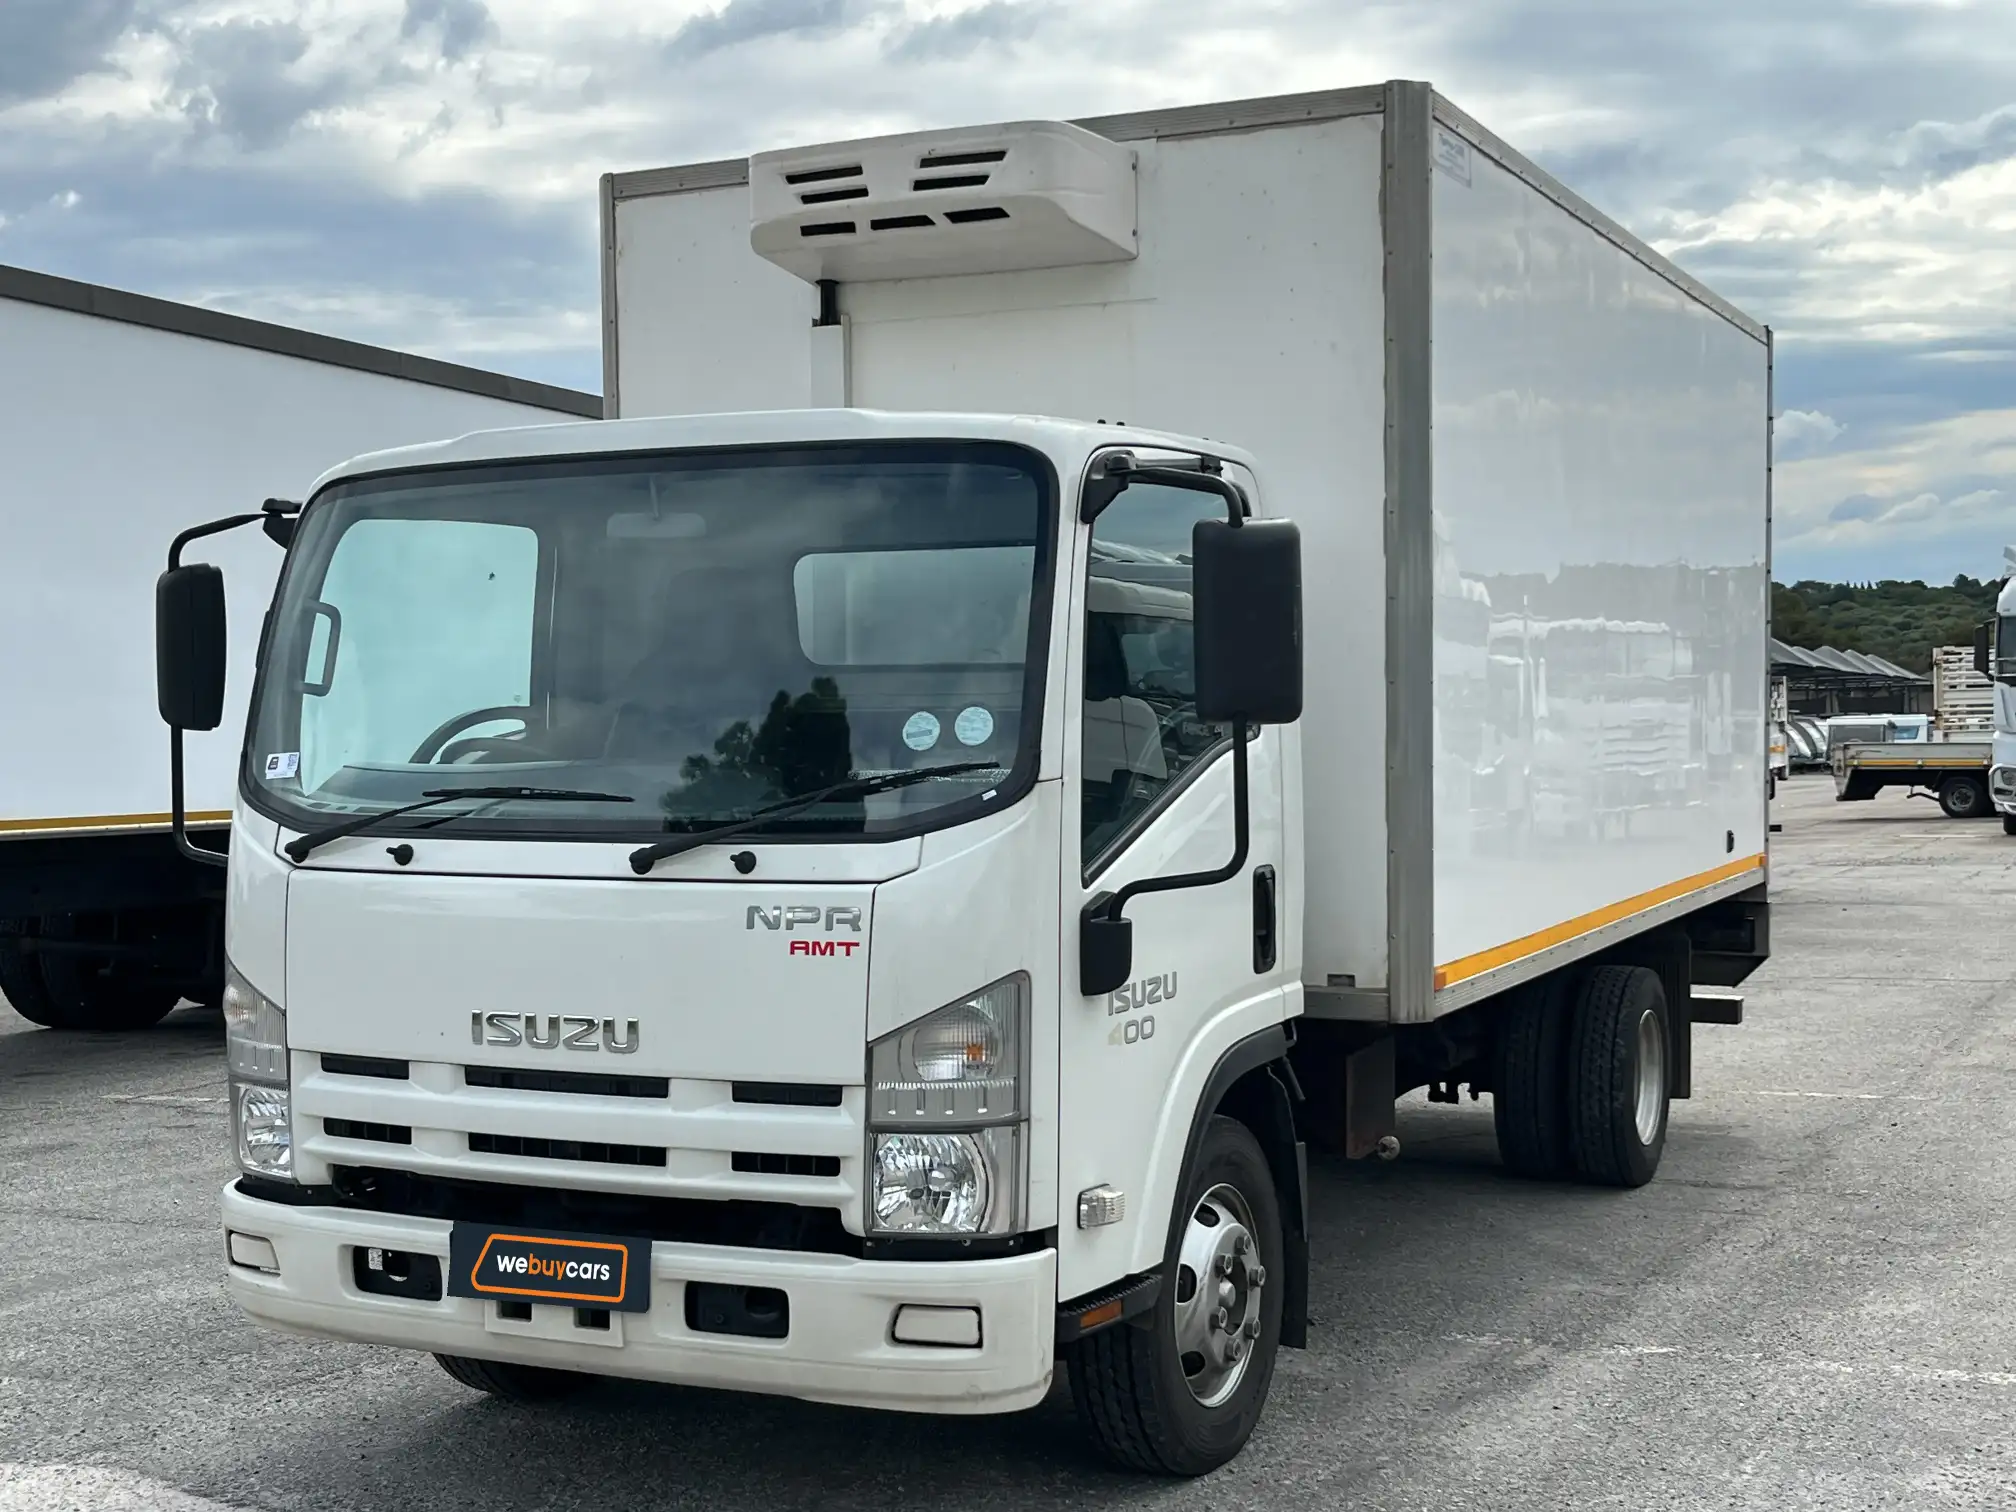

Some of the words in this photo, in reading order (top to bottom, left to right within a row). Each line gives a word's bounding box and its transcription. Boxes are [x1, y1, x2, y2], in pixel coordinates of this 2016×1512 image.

[746, 905, 862, 932] NPR
[789, 940, 860, 957] AMT
[1108, 971, 1177, 1016] ISUZU
[471, 1009, 640, 1054] ISUZU
[496, 1253, 610, 1281] webuycars
